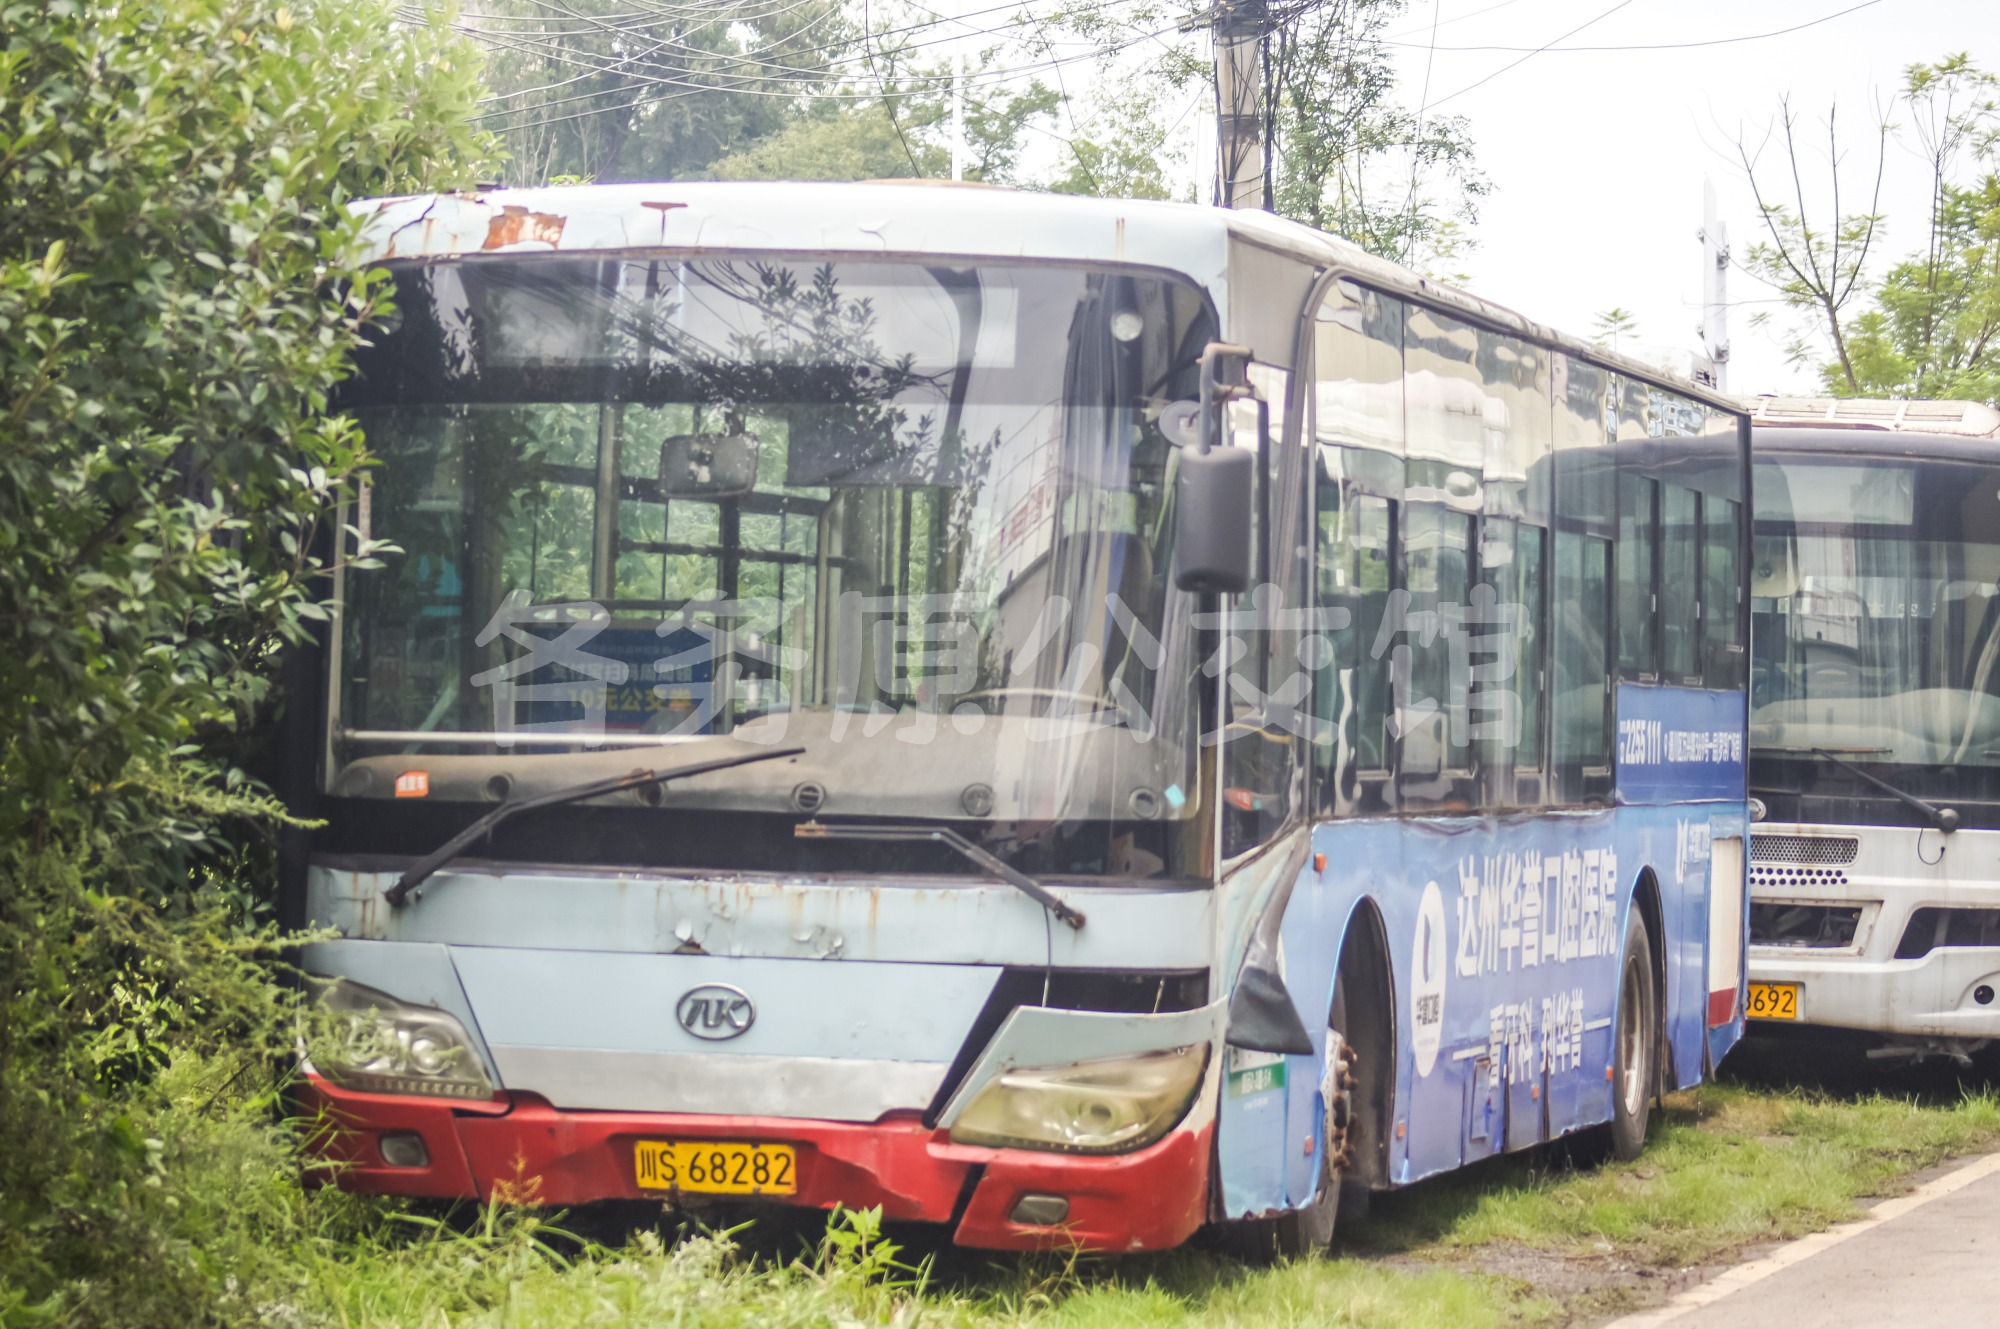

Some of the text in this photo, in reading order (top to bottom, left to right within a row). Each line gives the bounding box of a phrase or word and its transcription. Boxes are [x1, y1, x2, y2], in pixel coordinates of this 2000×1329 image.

[1455, 844, 1618, 978] 达州华誉口腔医院
